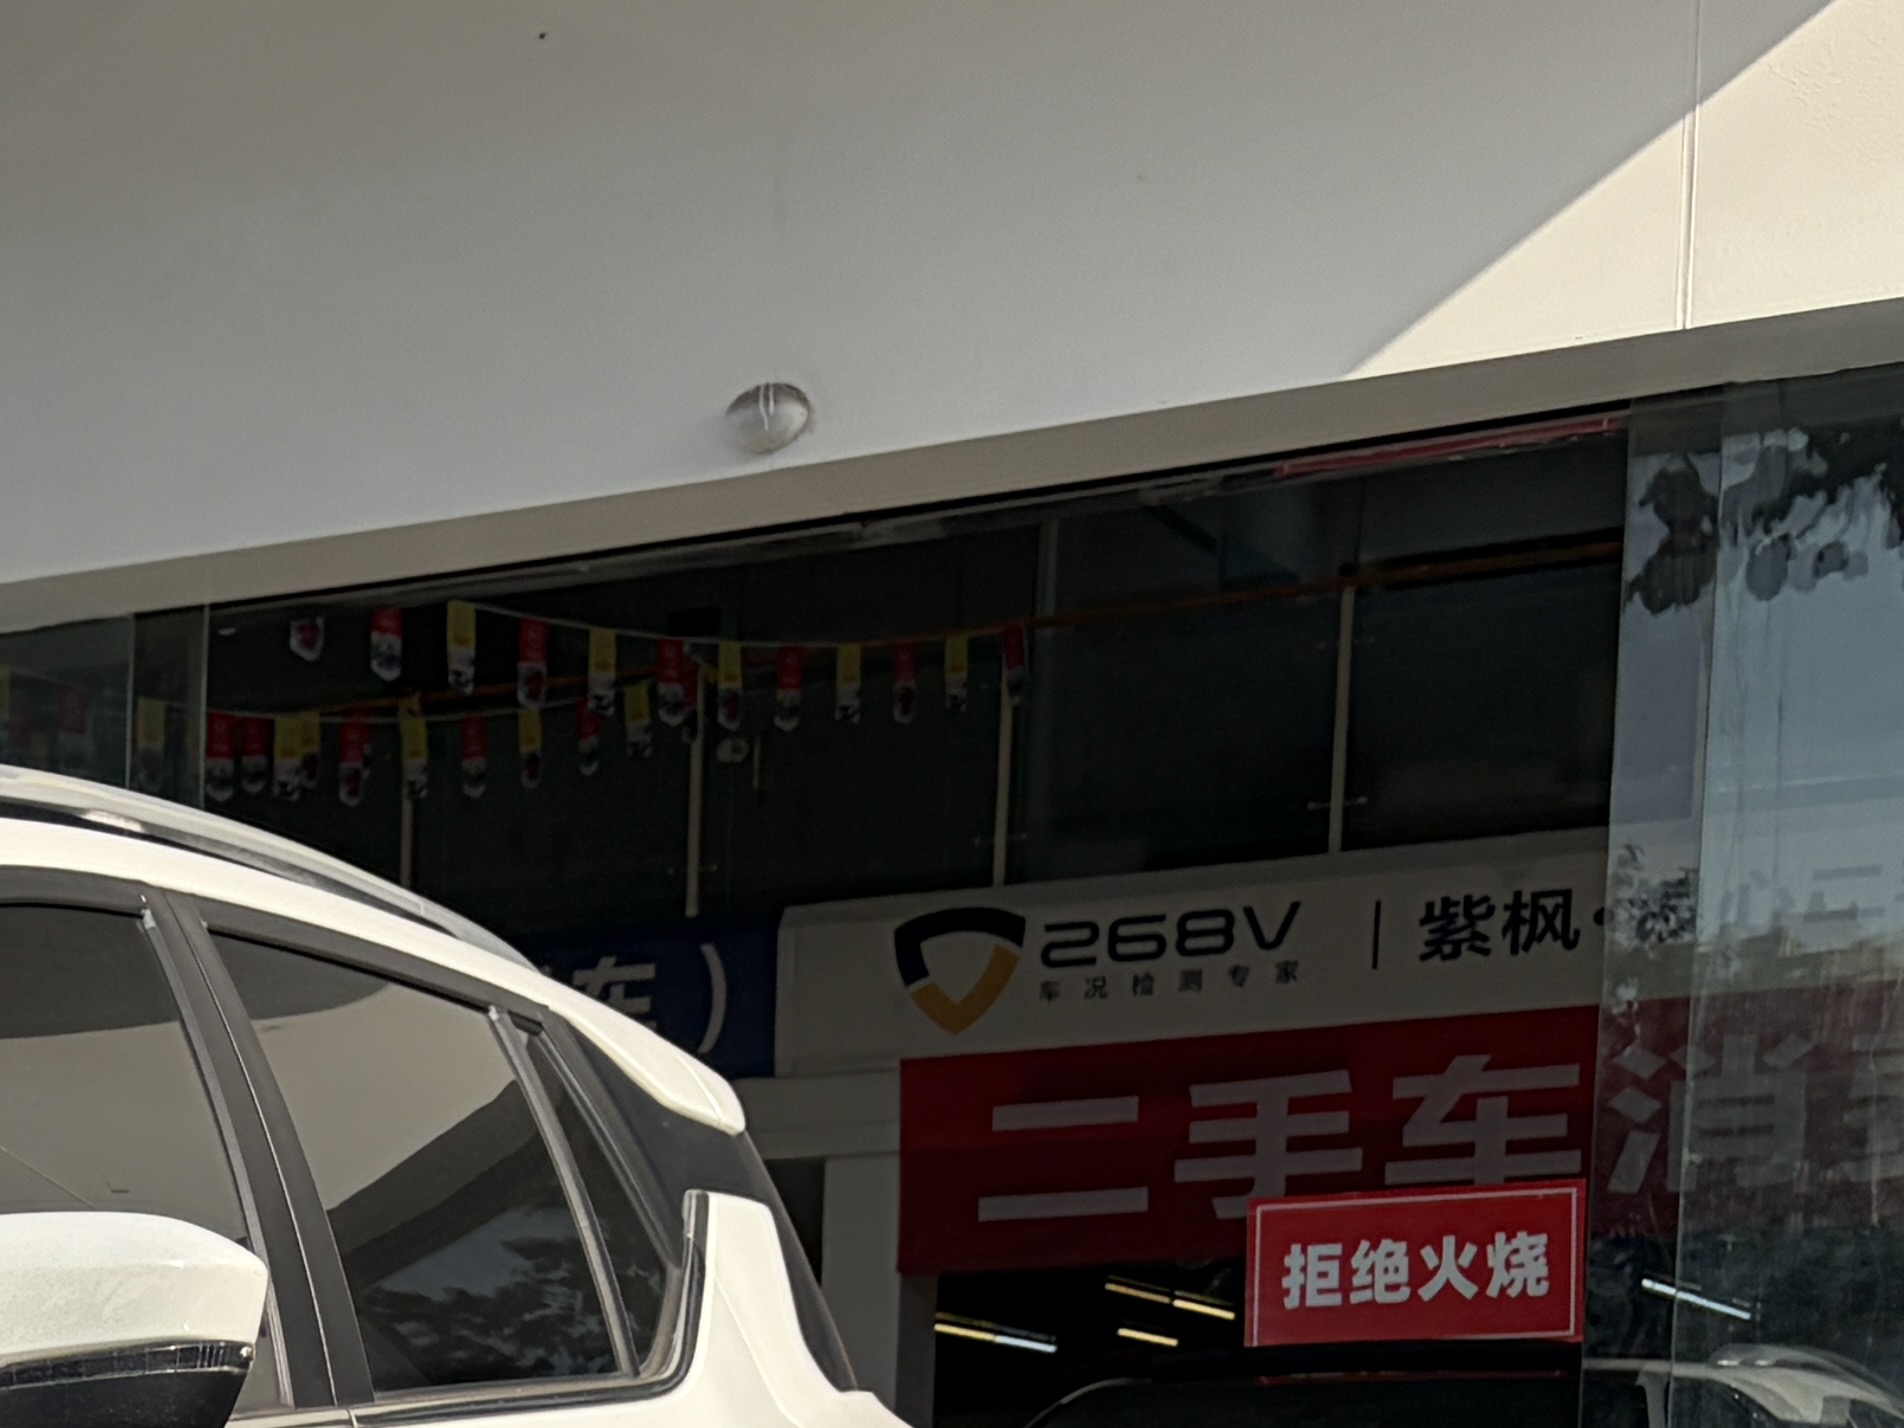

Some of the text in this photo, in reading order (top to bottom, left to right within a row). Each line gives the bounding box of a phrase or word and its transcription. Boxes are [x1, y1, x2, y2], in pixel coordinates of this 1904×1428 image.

[1039, 900, 1301, 969] 268V
[1281, 1230, 1551, 1311] 拒绝火烧
